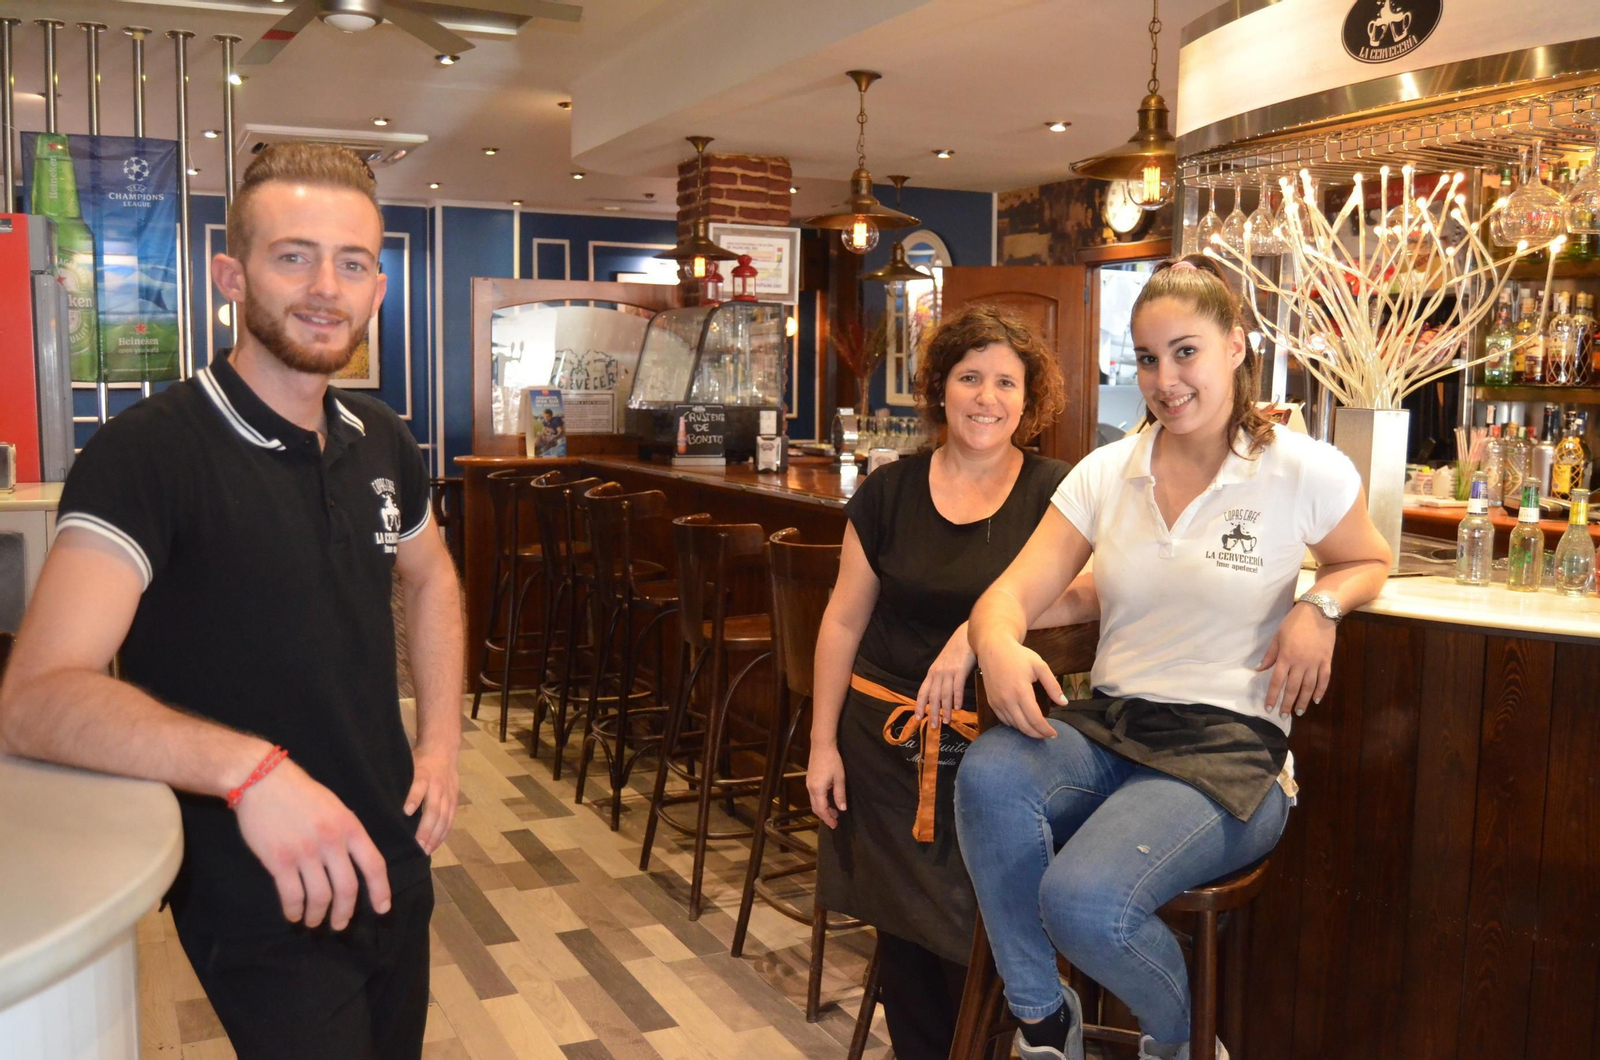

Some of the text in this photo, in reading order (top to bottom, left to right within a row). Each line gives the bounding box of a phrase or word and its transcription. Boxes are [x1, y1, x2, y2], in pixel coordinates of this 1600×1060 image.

[1359, 34, 1418, 60] LA CERVECERÍA
[50, 155, 58, 199] Heineken
[126, 183, 147, 193] UEFA
[108, 191, 165, 202] CHAMPIONS
[69, 322, 90, 344] UALITY
[118, 336, 159, 347] Heineken
[118, 347, 133, 355] open
[693, 423, 710, 432] DE
[687, 433, 724, 445] BONITO
[1224, 509, 1261, 524] COPAS CAFÉ
[1205, 551, 1264, 567] LA CERVECERÍA
